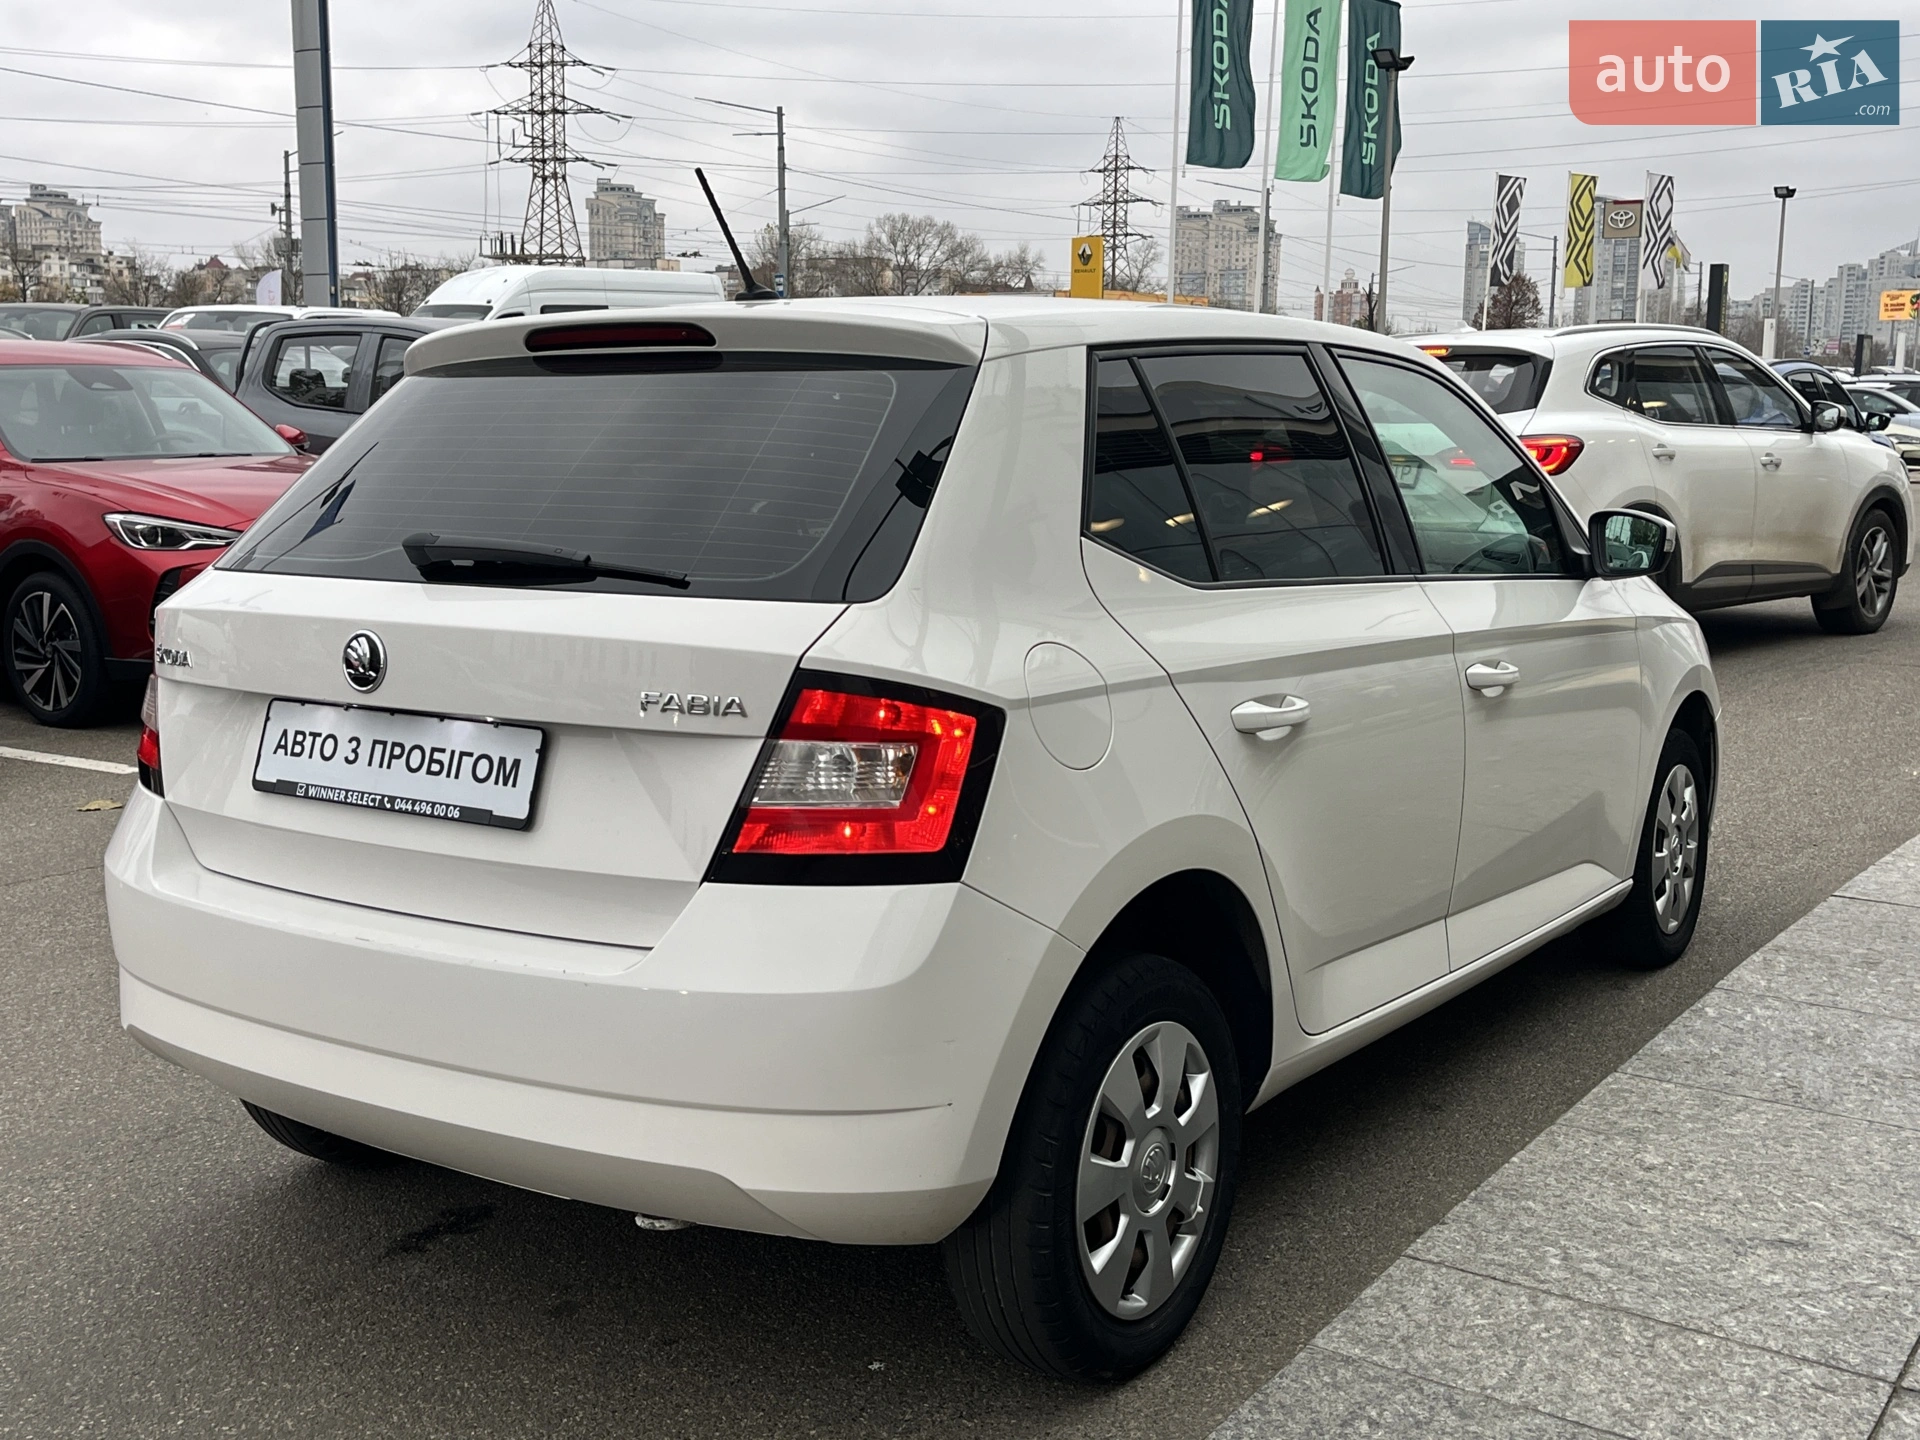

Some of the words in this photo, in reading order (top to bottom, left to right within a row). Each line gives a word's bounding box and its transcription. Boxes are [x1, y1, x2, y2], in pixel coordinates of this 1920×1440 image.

[640, 691, 748, 718] FABIA
[273, 728, 338, 762] АВТО
[367, 739, 521, 788] ПРОБІГОМ
[308, 785, 345, 802] WINNER
[346, 791, 381, 807] SELECT
[394, 798, 413, 812] 044
[414, 802, 432, 814] 496
[434, 804, 446, 817] 00
[447, 806, 460, 819] 06
